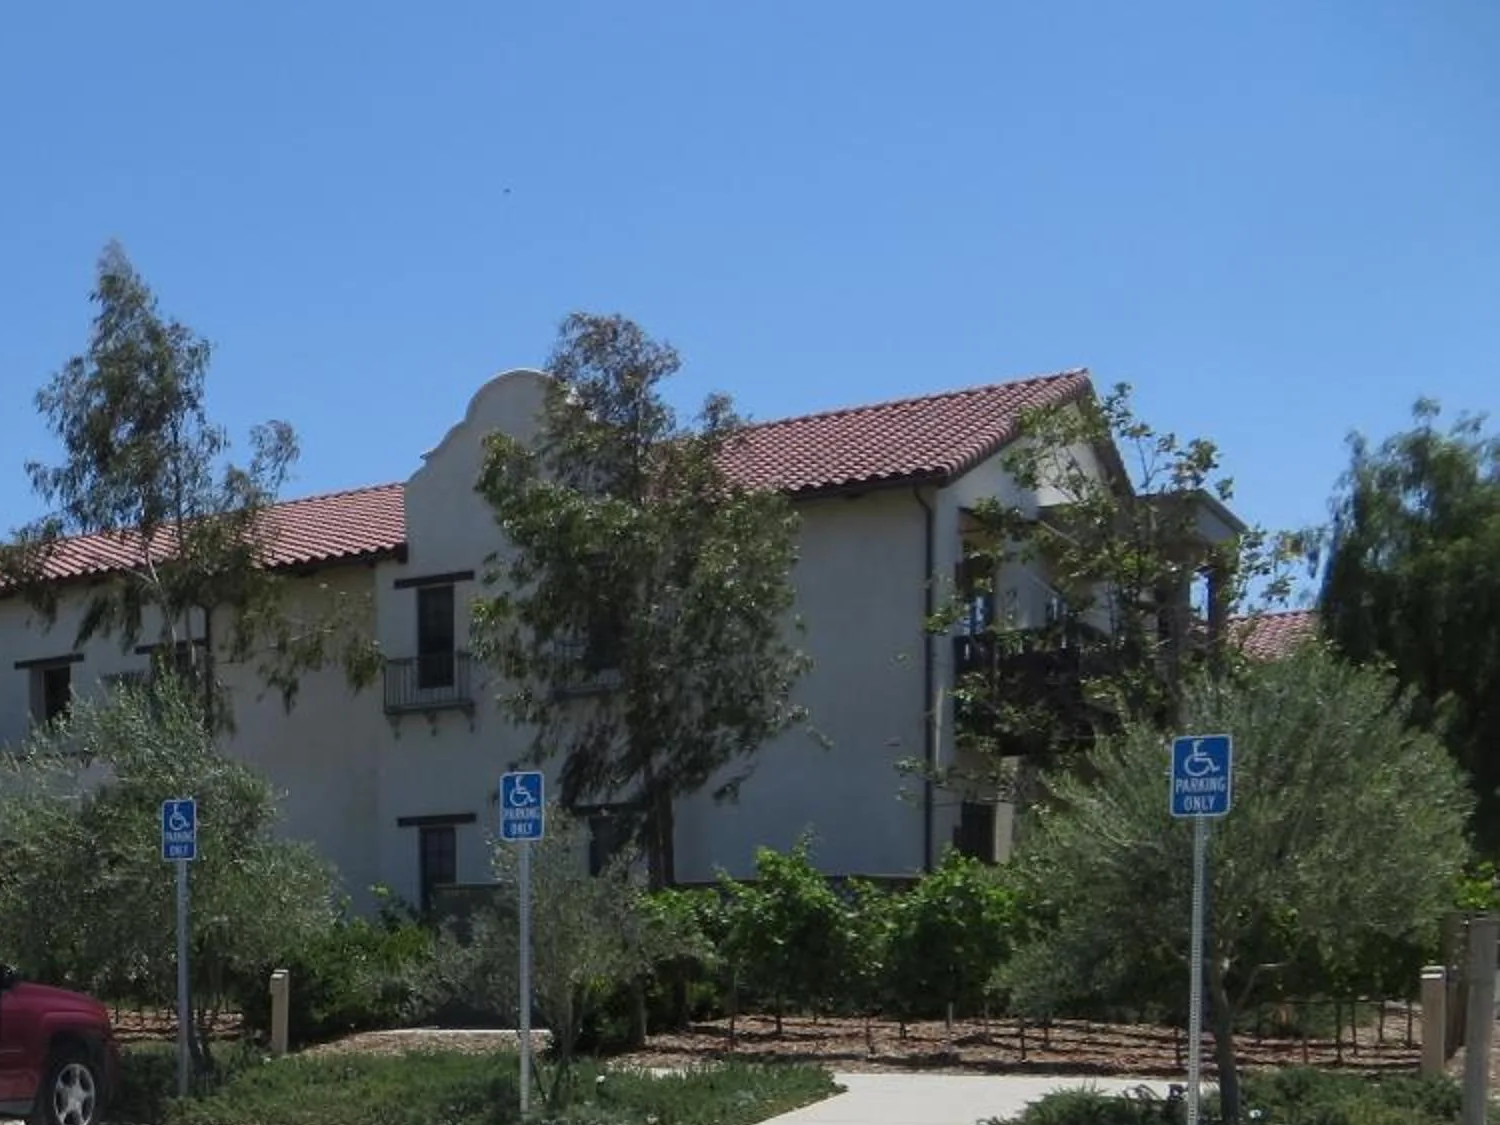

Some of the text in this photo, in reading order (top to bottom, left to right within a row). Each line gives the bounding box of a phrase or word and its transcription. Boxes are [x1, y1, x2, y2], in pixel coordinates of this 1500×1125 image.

[1175, 776, 1226, 793] PARKING
[1183, 795, 1216, 811] ONLY
[503, 807, 540, 819] PARKING
[510, 822, 534, 835] ONLY
